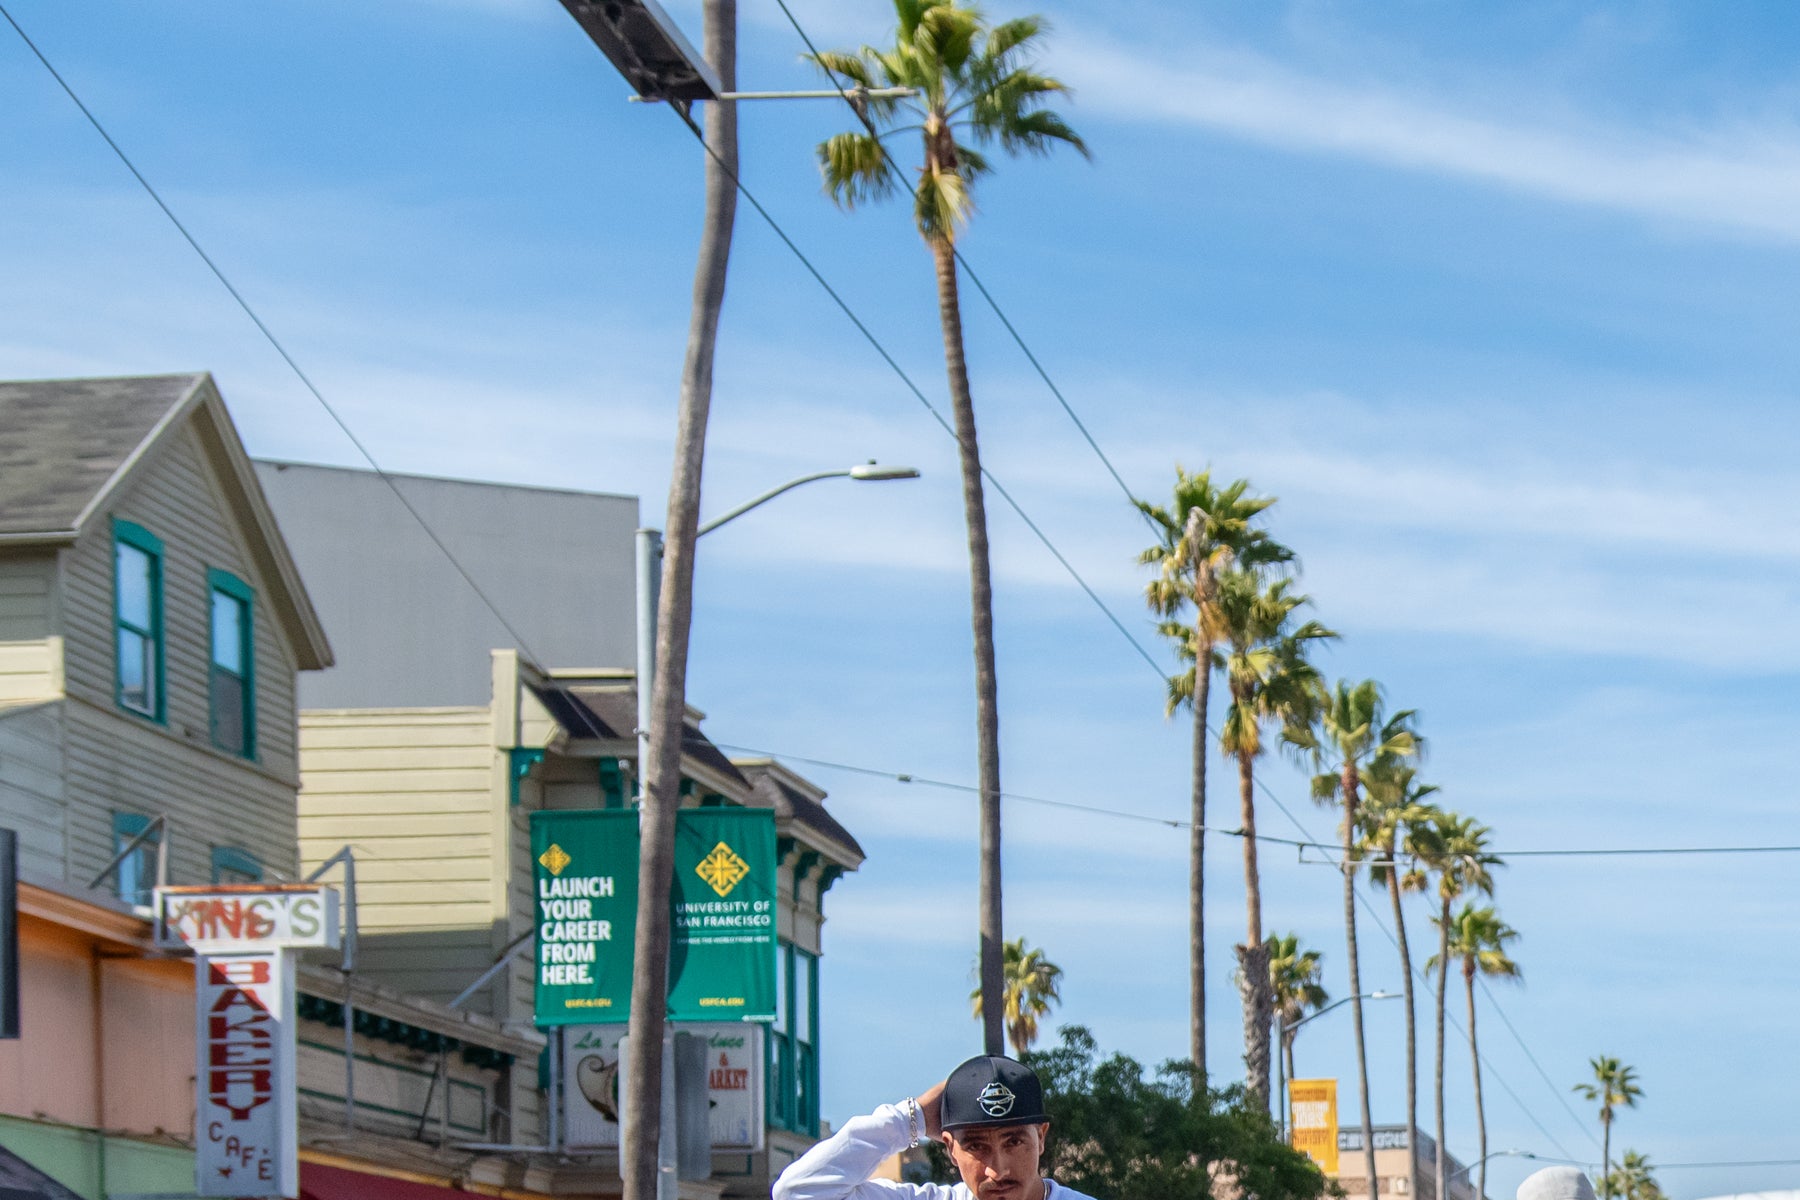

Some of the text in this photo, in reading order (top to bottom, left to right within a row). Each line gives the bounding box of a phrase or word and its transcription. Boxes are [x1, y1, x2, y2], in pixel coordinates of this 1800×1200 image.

[540, 876, 614, 897] LAUNCH
[540, 899, 592, 920] YOUR
[676, 900, 770, 913] UNIVERSITY OF
[676, 914, 770, 927] SAN FRANCISCO
[541, 921, 612, 942] CAREER
[541, 943, 595, 964] FROM
[541, 964, 593, 985] HERE.
[208, 961, 273, 1121] BAKERY
[709, 1069, 748, 1091] ARKET
